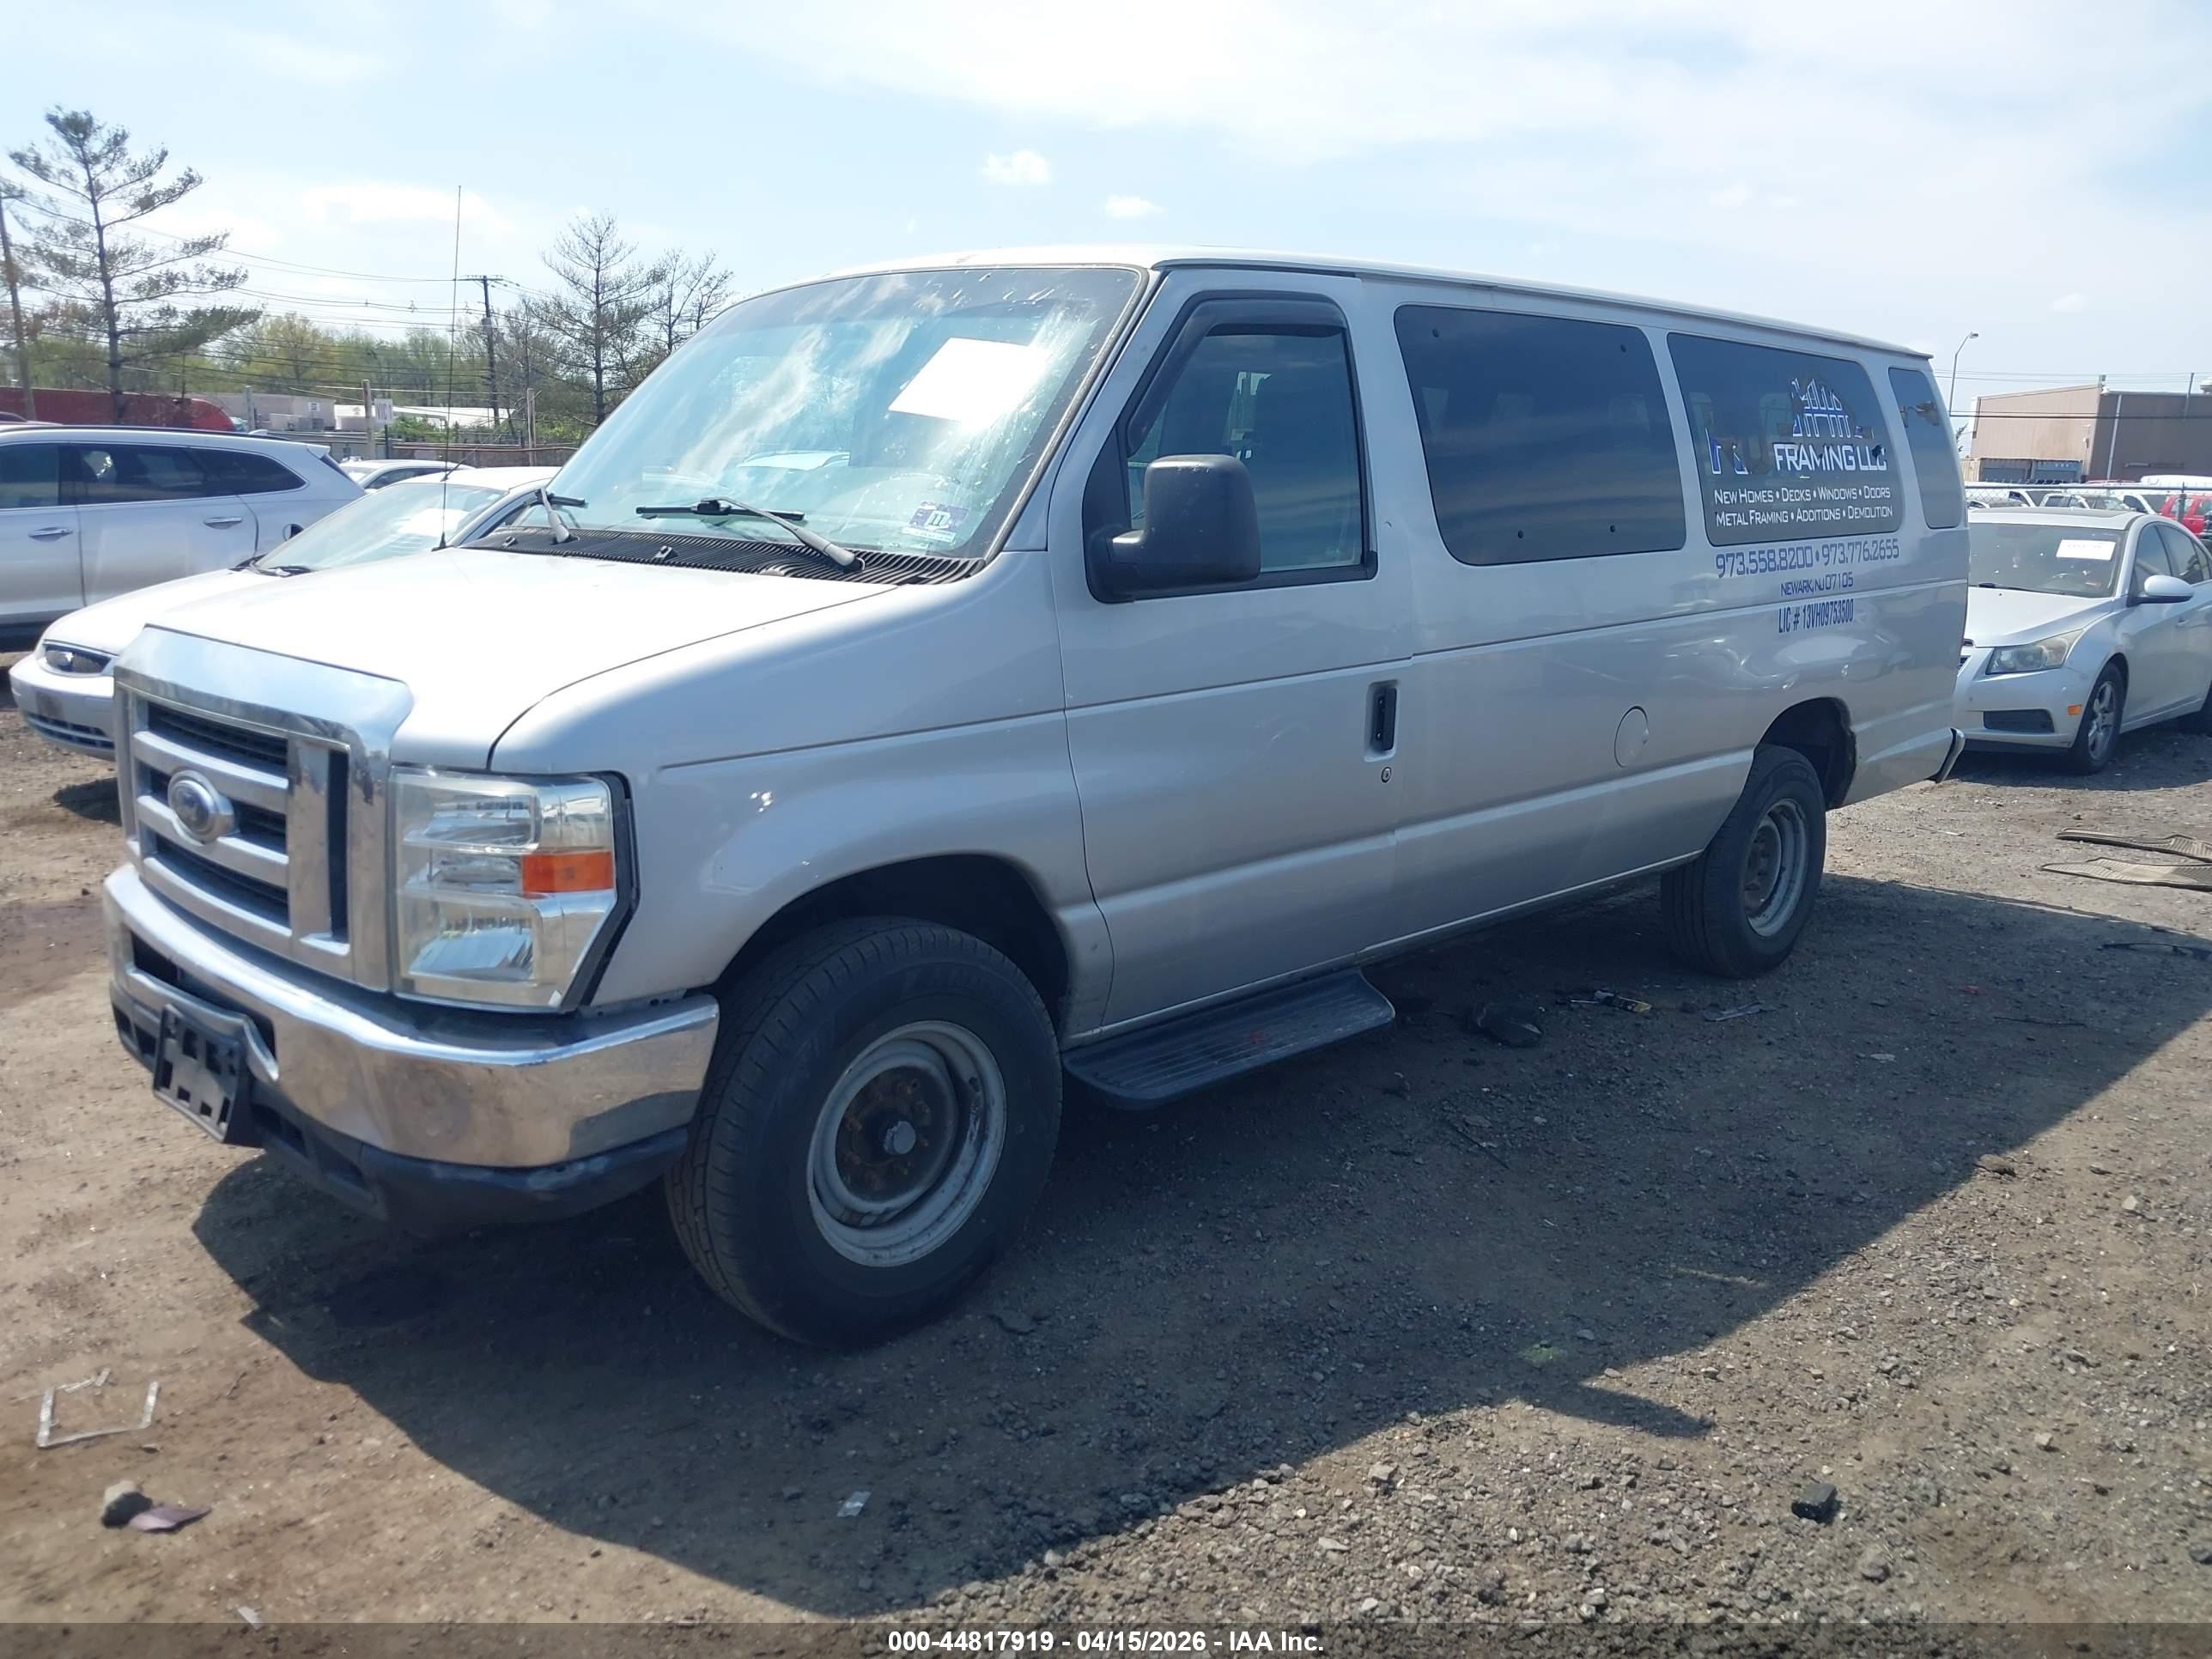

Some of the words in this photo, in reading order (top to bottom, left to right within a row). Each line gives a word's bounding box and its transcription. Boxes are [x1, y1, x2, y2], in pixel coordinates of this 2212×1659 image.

[1773, 442, 1855, 471] FRAMING
[1714, 489, 1738, 505] NEW
[1740, 487, 1774, 503] HOMES
[1781, 487, 1811, 502] DECKS
[1816, 486, 1857, 501] WINDOWS
[1863, 485, 1890, 499] DOORS
[1716, 512, 1748, 526] METAL
[1749, 510, 1789, 525] FRAMING
[1796, 507, 1841, 522] ADDITIONS
[1848, 505, 1893, 519] DEMOLITION
[1716, 545, 1813, 579] 973.558.8200
[1821, 538, 1899, 566] 973.776.2655
[1778, 606, 1790, 634] LIC
[1793, 607, 1800, 631] #
